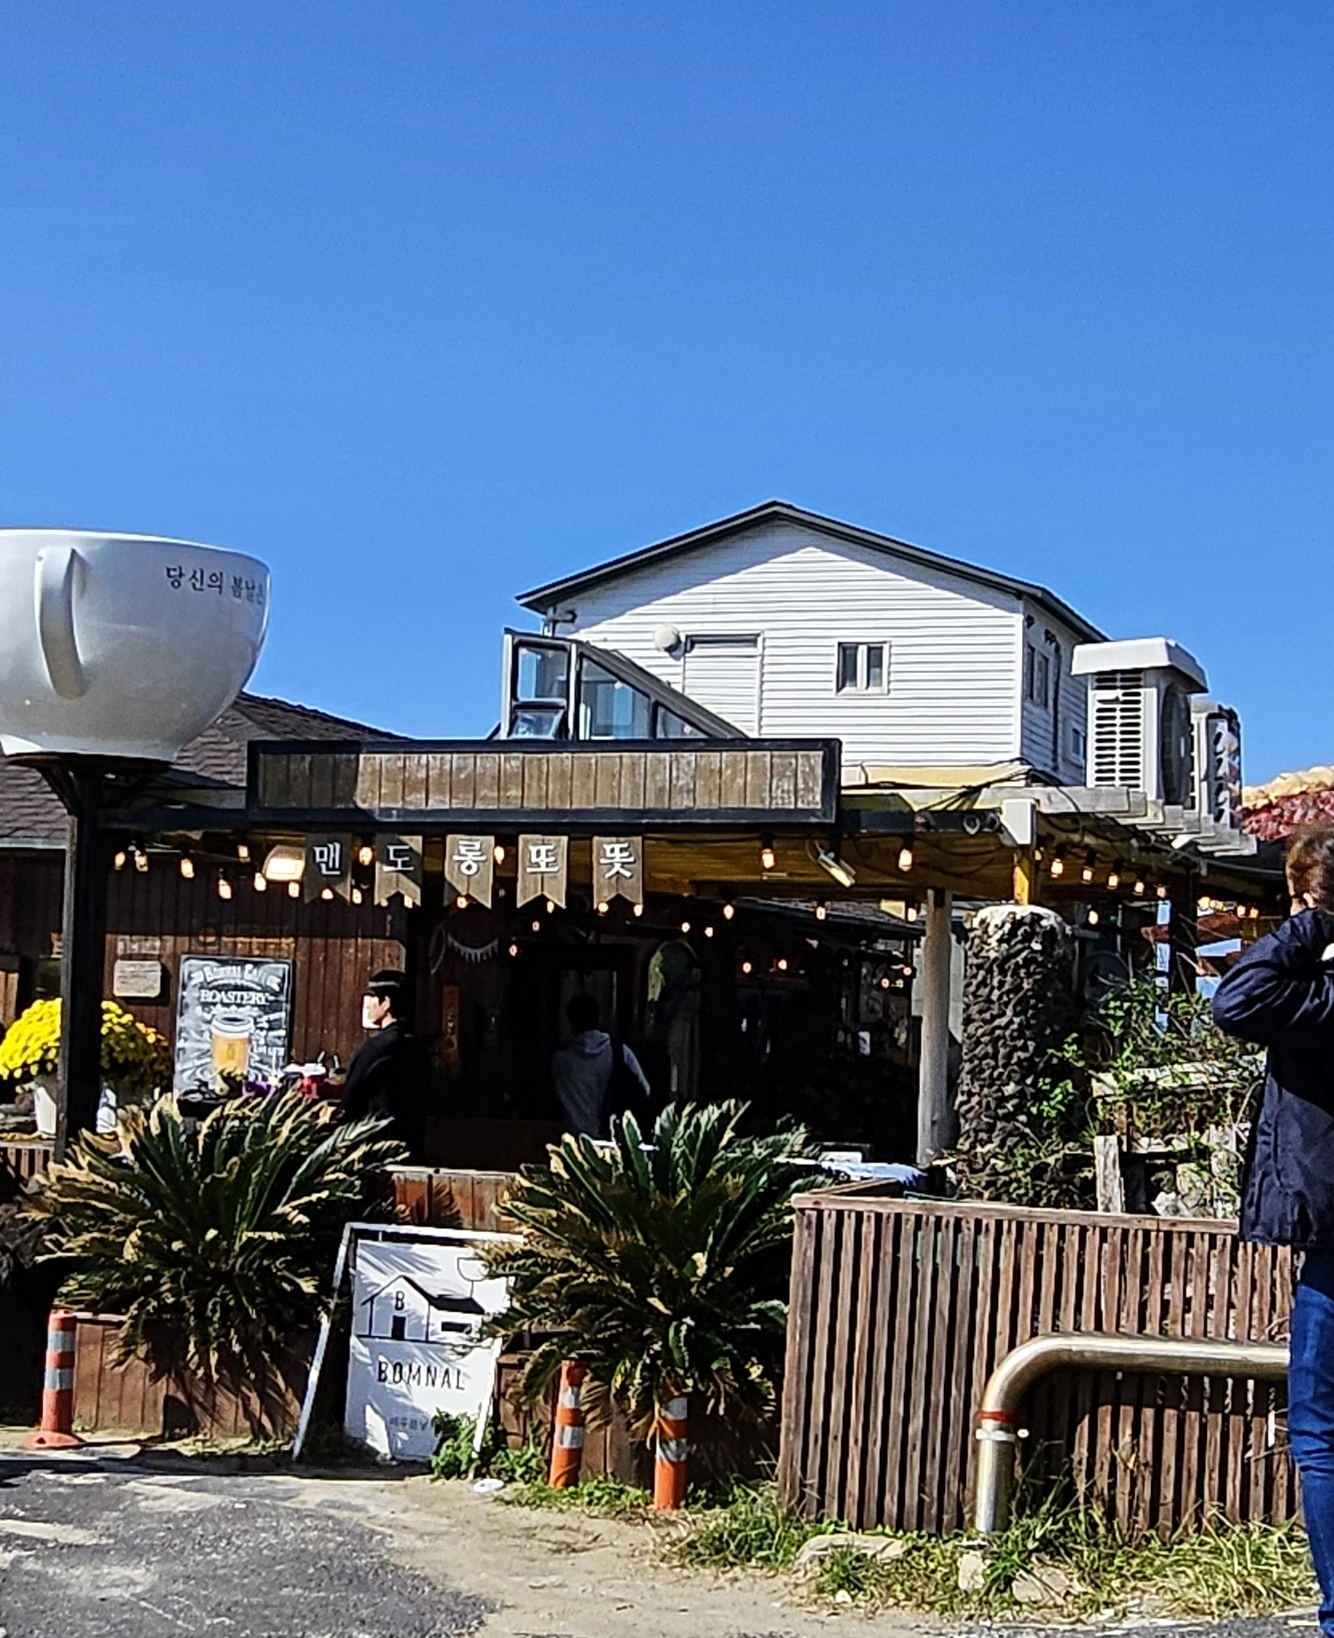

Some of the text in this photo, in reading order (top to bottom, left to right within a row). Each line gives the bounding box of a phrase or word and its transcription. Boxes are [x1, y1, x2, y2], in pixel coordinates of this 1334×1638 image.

[165, 564, 224, 595] 당신의
[394, 1290, 406, 1311] B
[377, 1360, 466, 1391] BOMNAL
